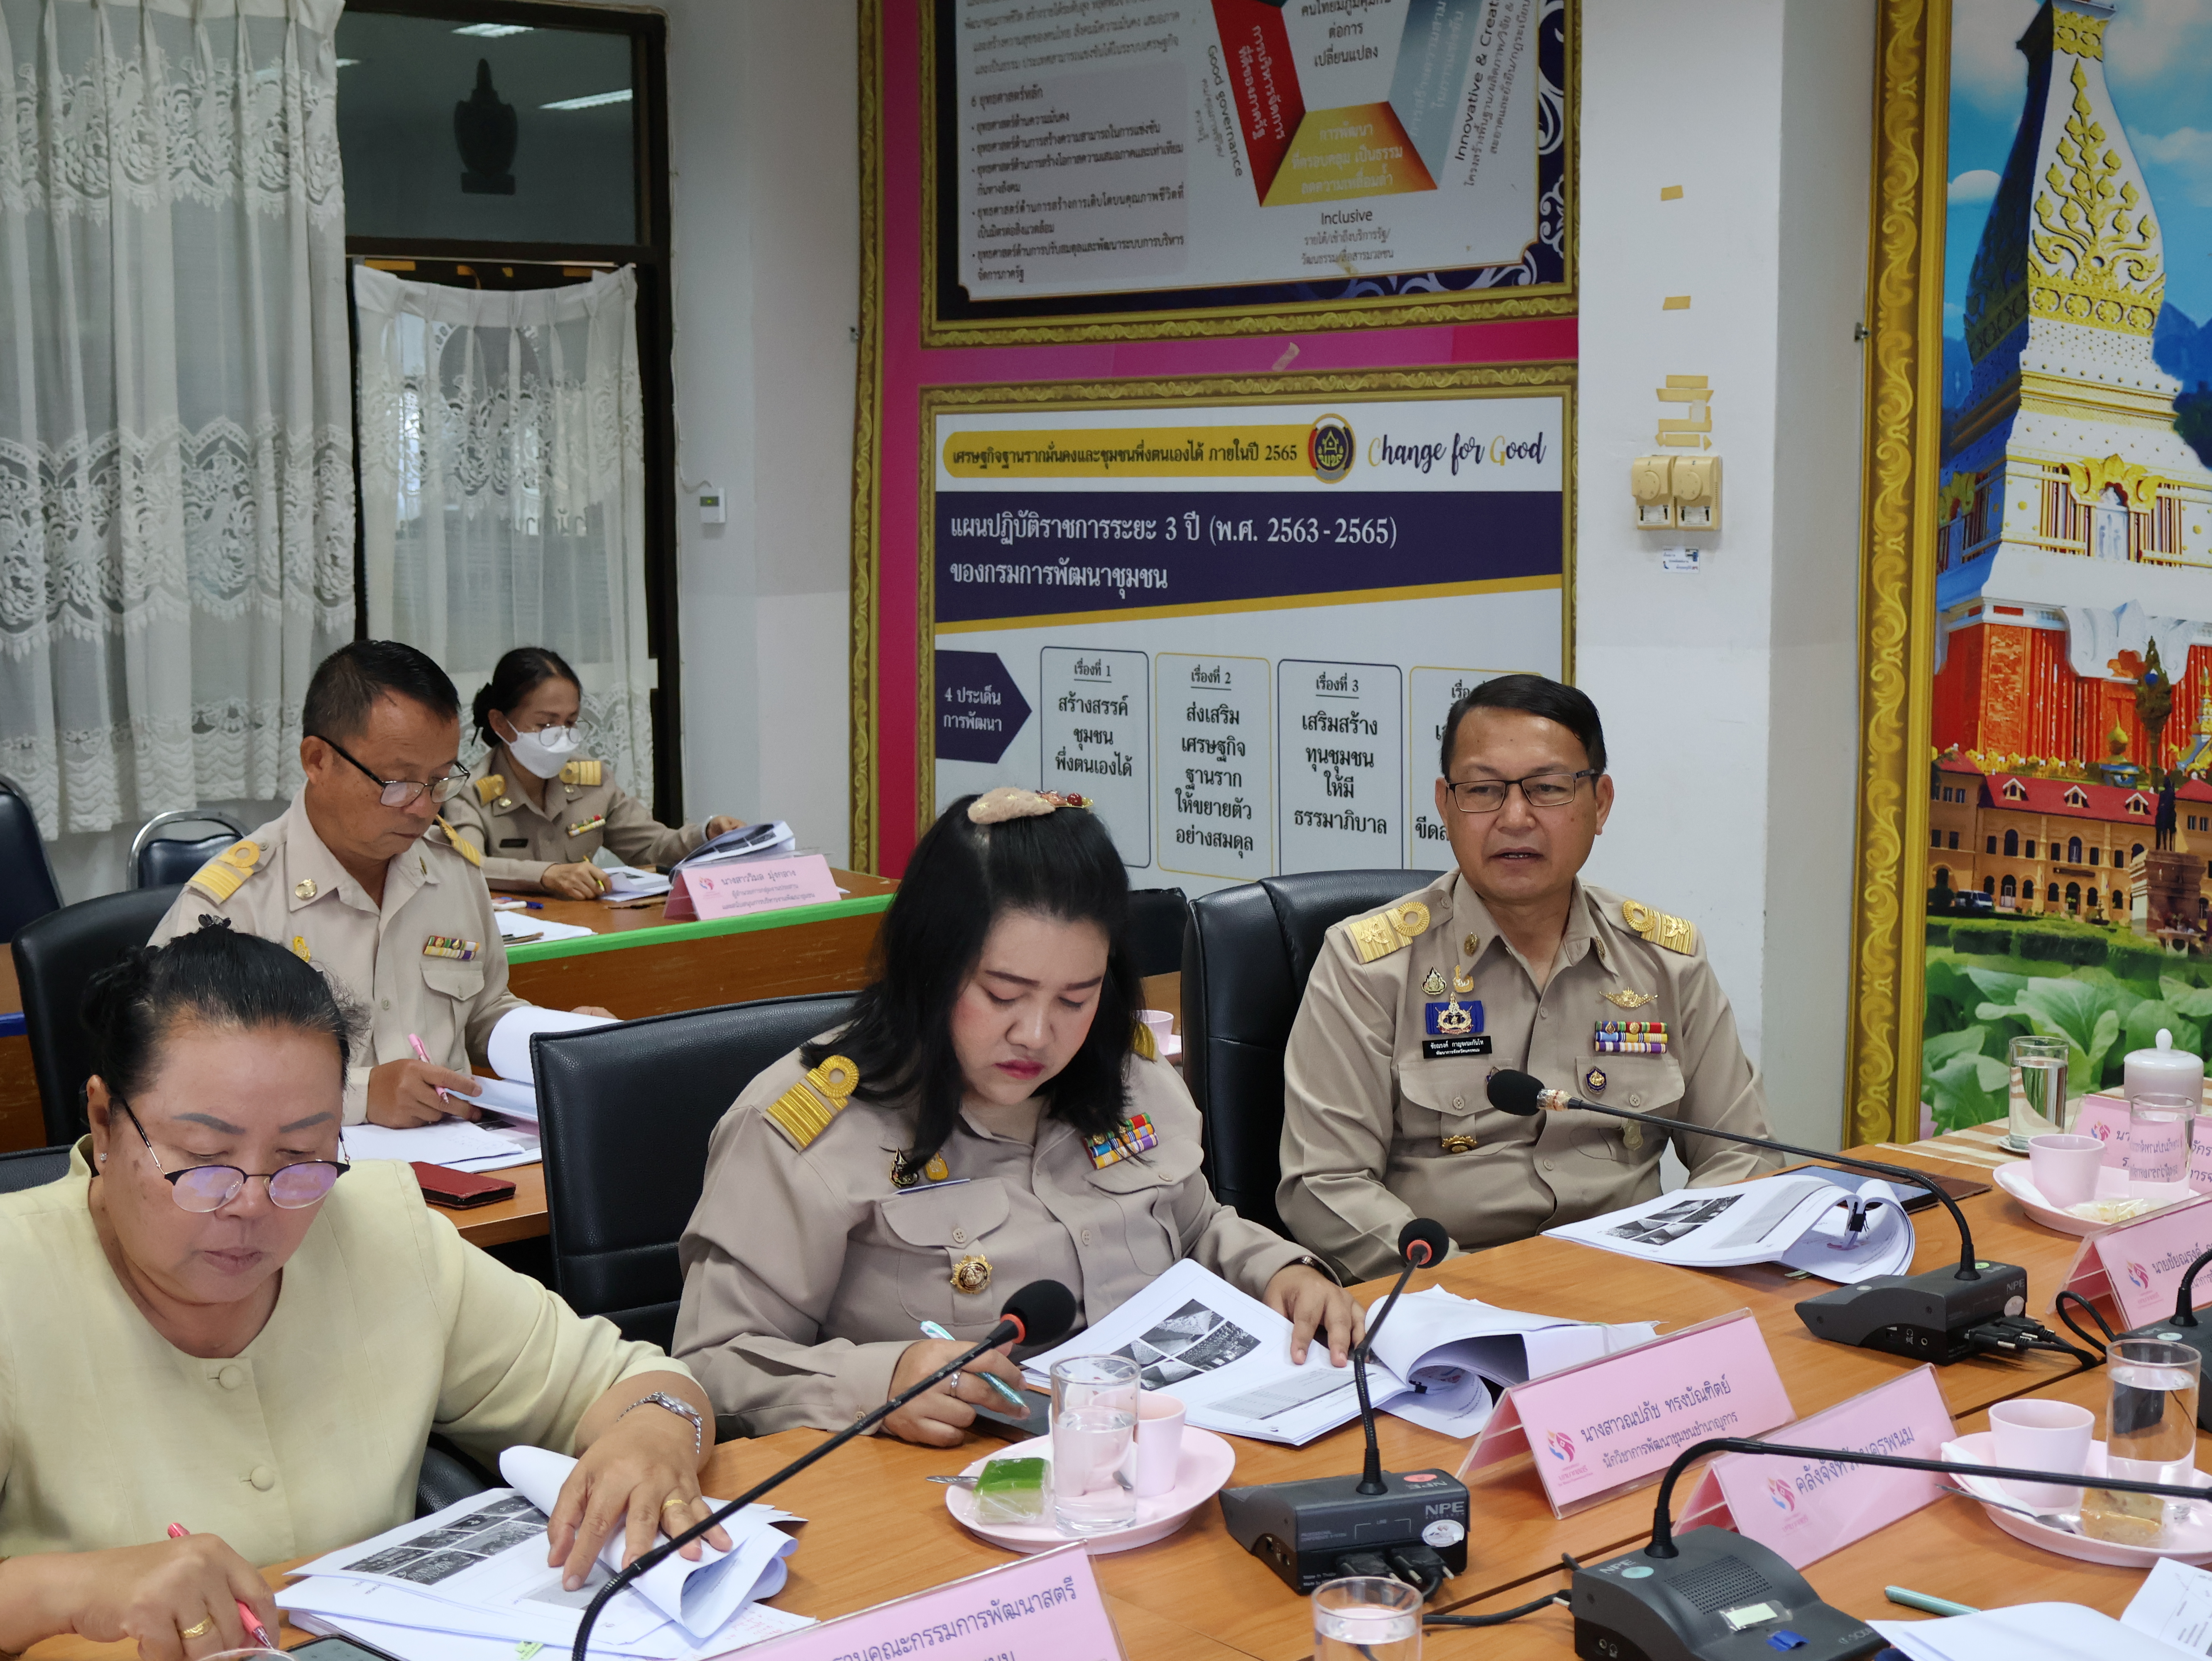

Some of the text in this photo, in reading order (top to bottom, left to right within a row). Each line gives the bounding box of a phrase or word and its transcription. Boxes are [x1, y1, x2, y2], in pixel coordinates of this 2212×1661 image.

[1329, 22, 1363, 39] ต่อการ
[1314, 44, 1378, 67] เปลี่ยนแปลง
[1252, 25, 1286, 140] การบริหารจัดการ
[1454, 0, 1500, 161] Innovative & Creat
[1207, 45, 1242, 177] Good governance
[1321, 208, 1373, 225] Inclusive
[953, 438, 1297, 470] เศรษฐกิจฐานรากมั่นคงและชุมชนพึ่งตนเองได้ ภายในปี 2565
[1368, 432, 1547, 476] Change for Good
[950, 510, 1157, 545] แผนปฏิบัติราชการระยะ
[1165, 516, 1177, 541] 3
[1184, 511, 1200, 541] ปี
[1210, 515, 1258, 546] (พ.ศ.
[950, 557, 1168, 599] ของกรมการพัฒนาชุมชน
[1074, 659, 1111, 677] เรื่องที่ 1
[1191, 665, 1231, 685] เรื่องที่ 2
[1316, 672, 1359, 692] เรื่องที่ 3
[945, 685, 1001, 706] 4 ประเด็น
[1058, 692, 1128, 716] สร้างสรรค์
[943, 711, 1002, 732] การพัฒนา
[1186, 702, 1240, 725] ส่งเสริม
[1302, 710, 1378, 736] เสริมสร้าง
[1073, 728, 1114, 750] ชุมชน
[1181, 735, 1246, 762] เศรษฐกิจ
[1055, 746, 1133, 777] พึ่งตนเองได้
[1306, 747, 1374, 774] ทุนชุมชน
[1185, 767, 1242, 790] ฐานราก
[1324, 770, 1355, 799] ให้มี
[1175, 787, 1253, 821] ให้ขยายตัว
[1294, 809, 1387, 835] ธรรมาภิบาล
[1176, 826, 1253, 859] อย่างสมดุล
[1430, 1040, 1449, 1049] ชัยณรงค์
[1581, 1374, 1731, 1443] นางสาวณปภัช ทรงบัณฑิตย์
[1603, 1411, 1739, 1469] นักวิชาการพัฒนาชุมชนชำนาญการ
[1425, 1501, 1465, 1516] NPE
[1599, 1558, 1632, 1575] NPE
[832, 1576, 1078, 1661] านคณะกรรมการพัฒนาสตรี
